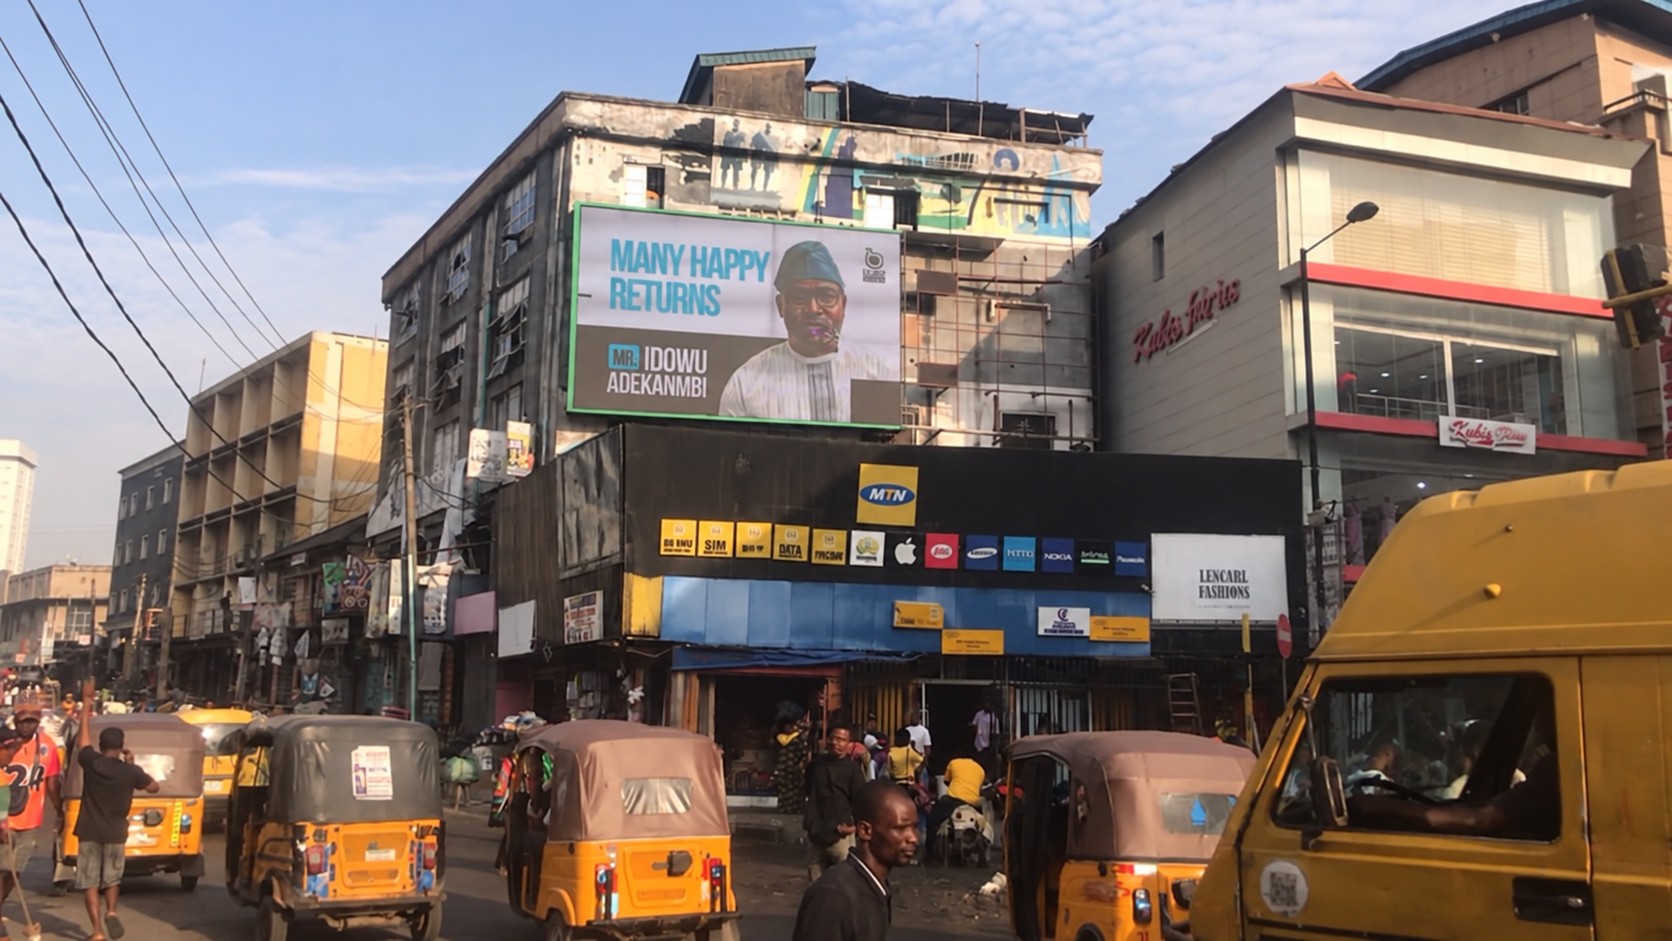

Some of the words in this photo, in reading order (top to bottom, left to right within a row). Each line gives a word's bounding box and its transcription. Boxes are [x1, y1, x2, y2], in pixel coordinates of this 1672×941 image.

[610, 238, 686, 275] MANY
[689, 246, 771, 283] HAPPY
[609, 277, 721, 317] RETURNS
[643, 346, 708, 374] IDOWU
[606, 371, 708, 398] ADEKANMBI
[1449, 421, 1494, 442] Kubis
[869, 488, 907, 503] MTN
[704, 539, 727, 551] SIM
[778, 543, 803, 556] DATA
[1044, 552, 1073, 562] NOKIA
[1199, 568, 1249, 584] LENCARL
[1199, 585, 1250, 600] FASHIONS
